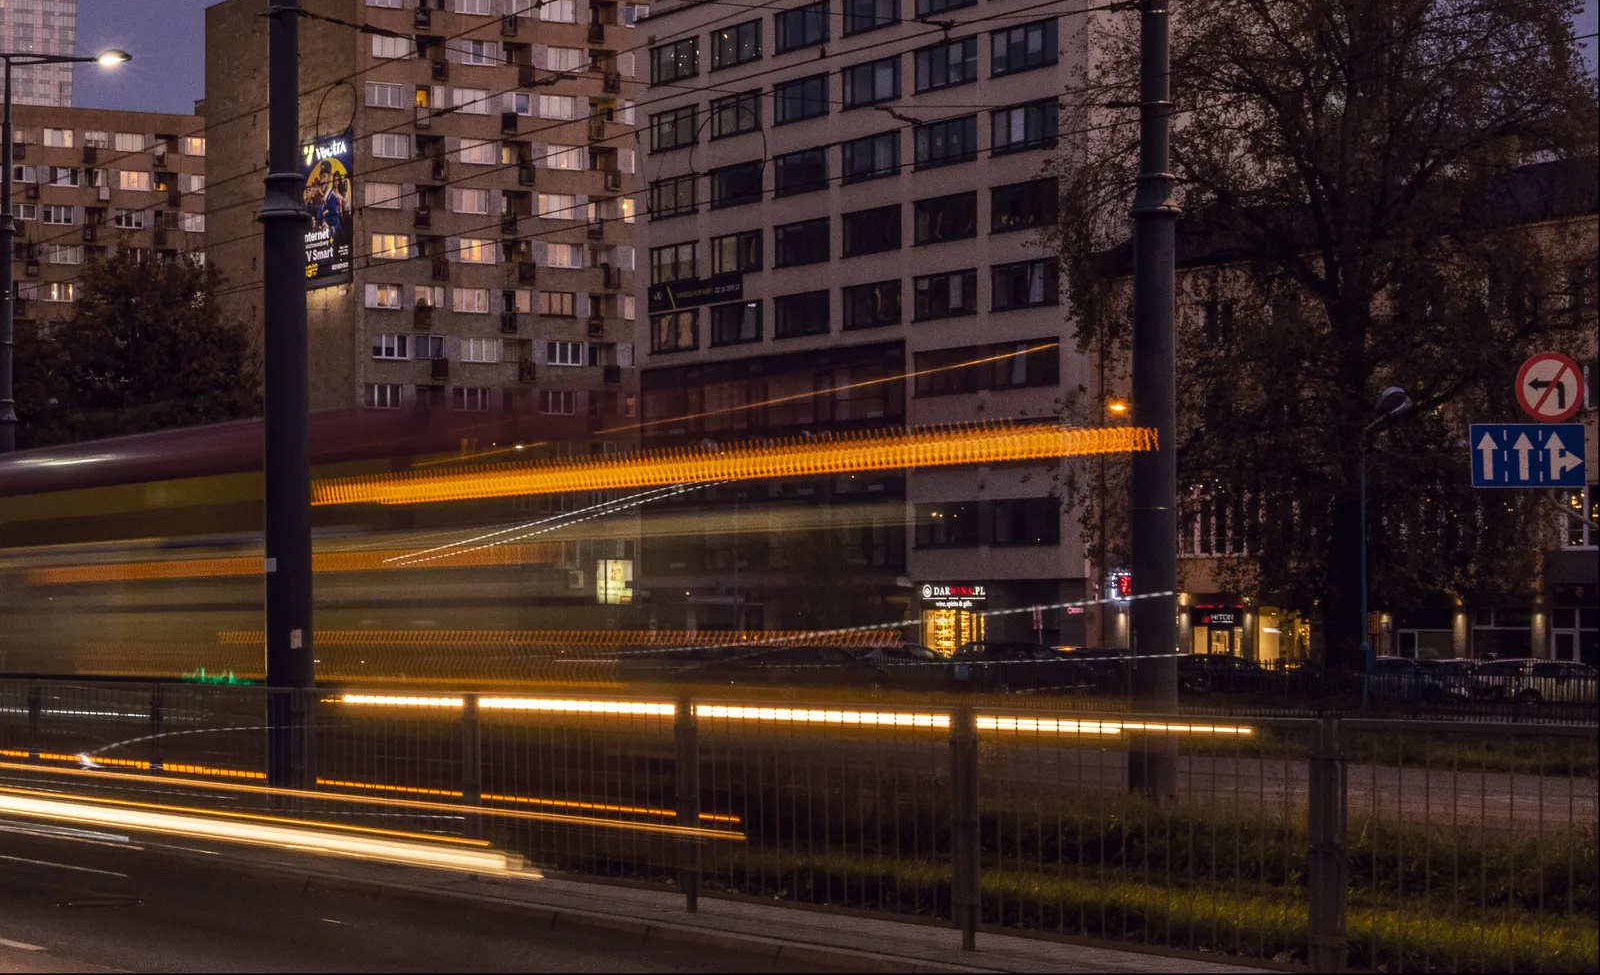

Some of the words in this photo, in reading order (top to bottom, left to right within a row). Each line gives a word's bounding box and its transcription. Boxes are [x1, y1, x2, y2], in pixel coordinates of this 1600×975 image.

[304, 228, 329, 243] nternet
[312, 247, 334, 261] Smart
[933, 586, 986, 596] DARWINA.PL
